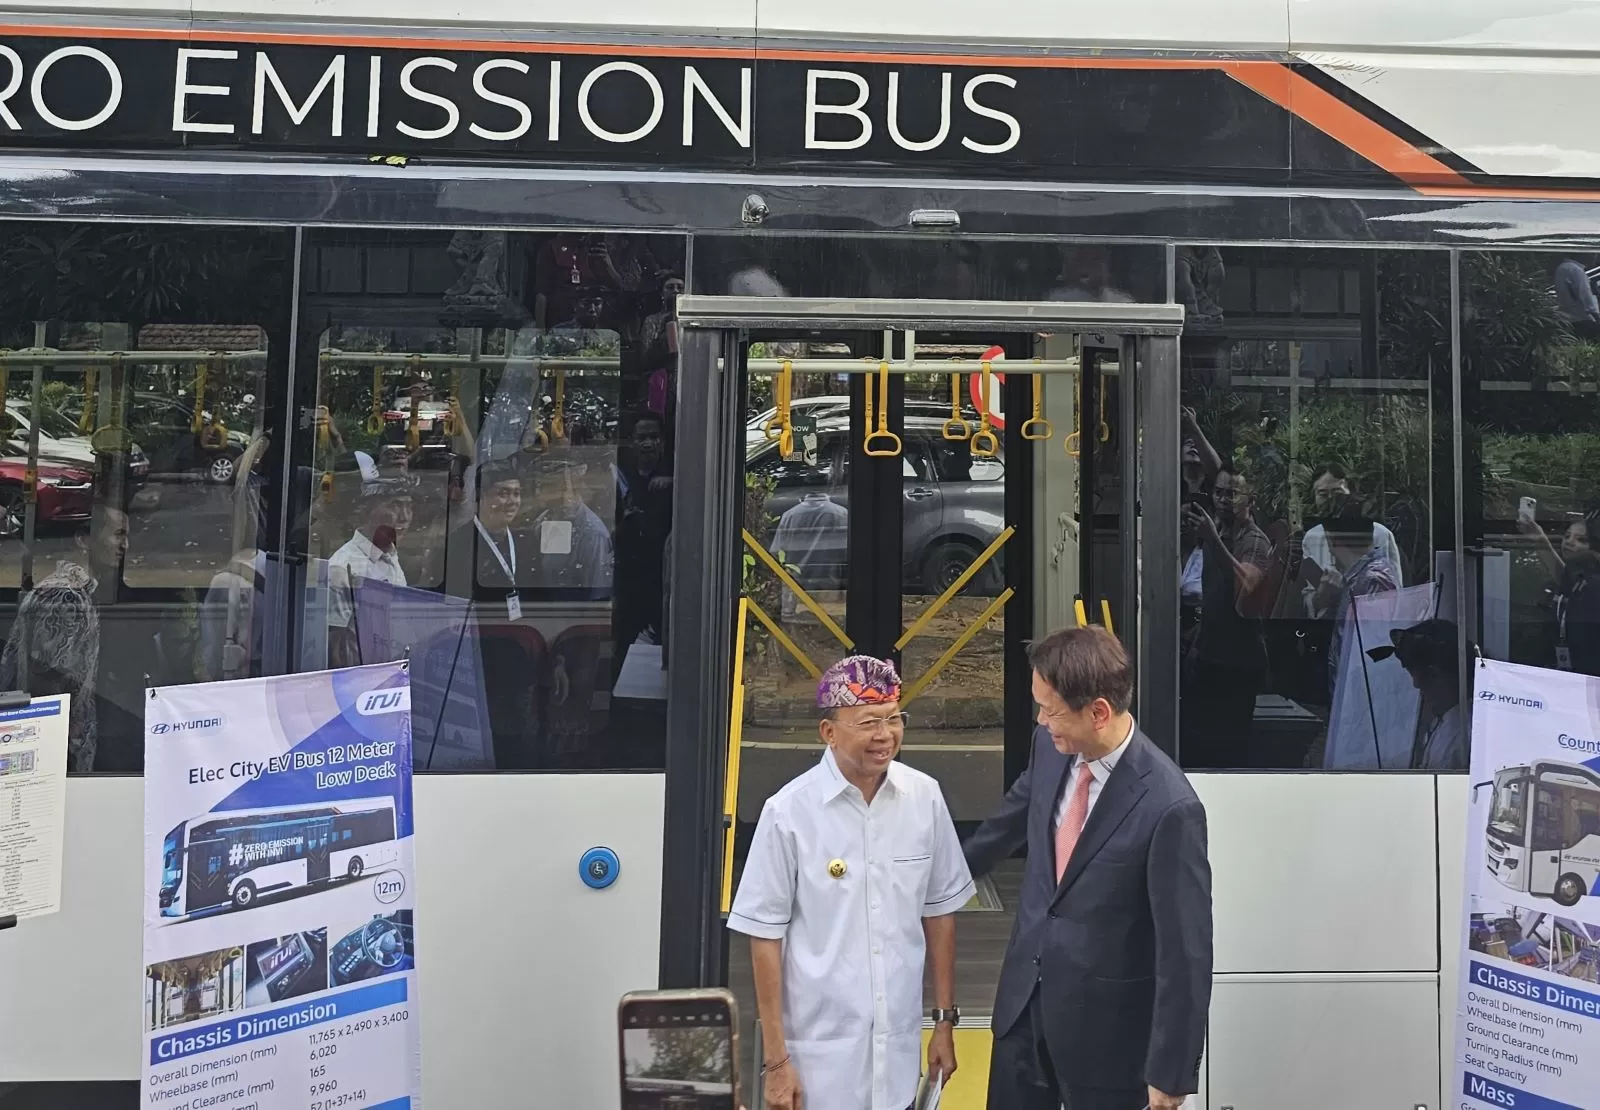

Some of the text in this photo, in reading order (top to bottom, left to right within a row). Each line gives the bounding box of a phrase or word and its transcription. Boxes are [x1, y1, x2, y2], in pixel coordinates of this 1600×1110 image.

[172, 48, 752, 149] EMISSION
[804, 69, 1021, 154] BUS
[1498, 694, 1543, 709] HYUNDAI
[172, 717, 222, 733] HYUNDAI
[189, 741, 395, 784] Elec City EV Bus 12 Meter
[318, 761, 397, 789] Low Deck
[244, 842, 268, 854] ZERO
[268, 836, 304, 849] EMISSION
[244, 850, 266, 862] WITH
[377, 879, 402, 895] 12m
[1477, 967, 1541, 999] Chassis
[346, 1021, 373, 1036] 2,490
[381, 1010, 410, 1027] 3,400
[1466, 1005, 1545, 1038] Wheelbase (mm)
[1467, 991, 1583, 1033] Overall Dimension (mm)
[157, 1003, 338, 1059] Chassis Dimension
[1466, 1022, 1578, 1065] Ground Clearance (mm)
[149, 1044, 278, 1087] Overall Dimension (mm)
[309, 1044, 338, 1062] 6,020
[1465, 1037, 1563, 1078] Turning Radius (mm)
[310, 1065, 327, 1079] 165
[1464, 1054, 1528, 1085] Seat Capacity
[149, 1070, 239, 1104] Wheelbase (mm)
[192, 1088, 245, 1110] Clearance
[247, 1079, 275, 1097] (mm)
[310, 1079, 338, 1097] 9,960
[1471, 1076, 1516, 1107] Mass
